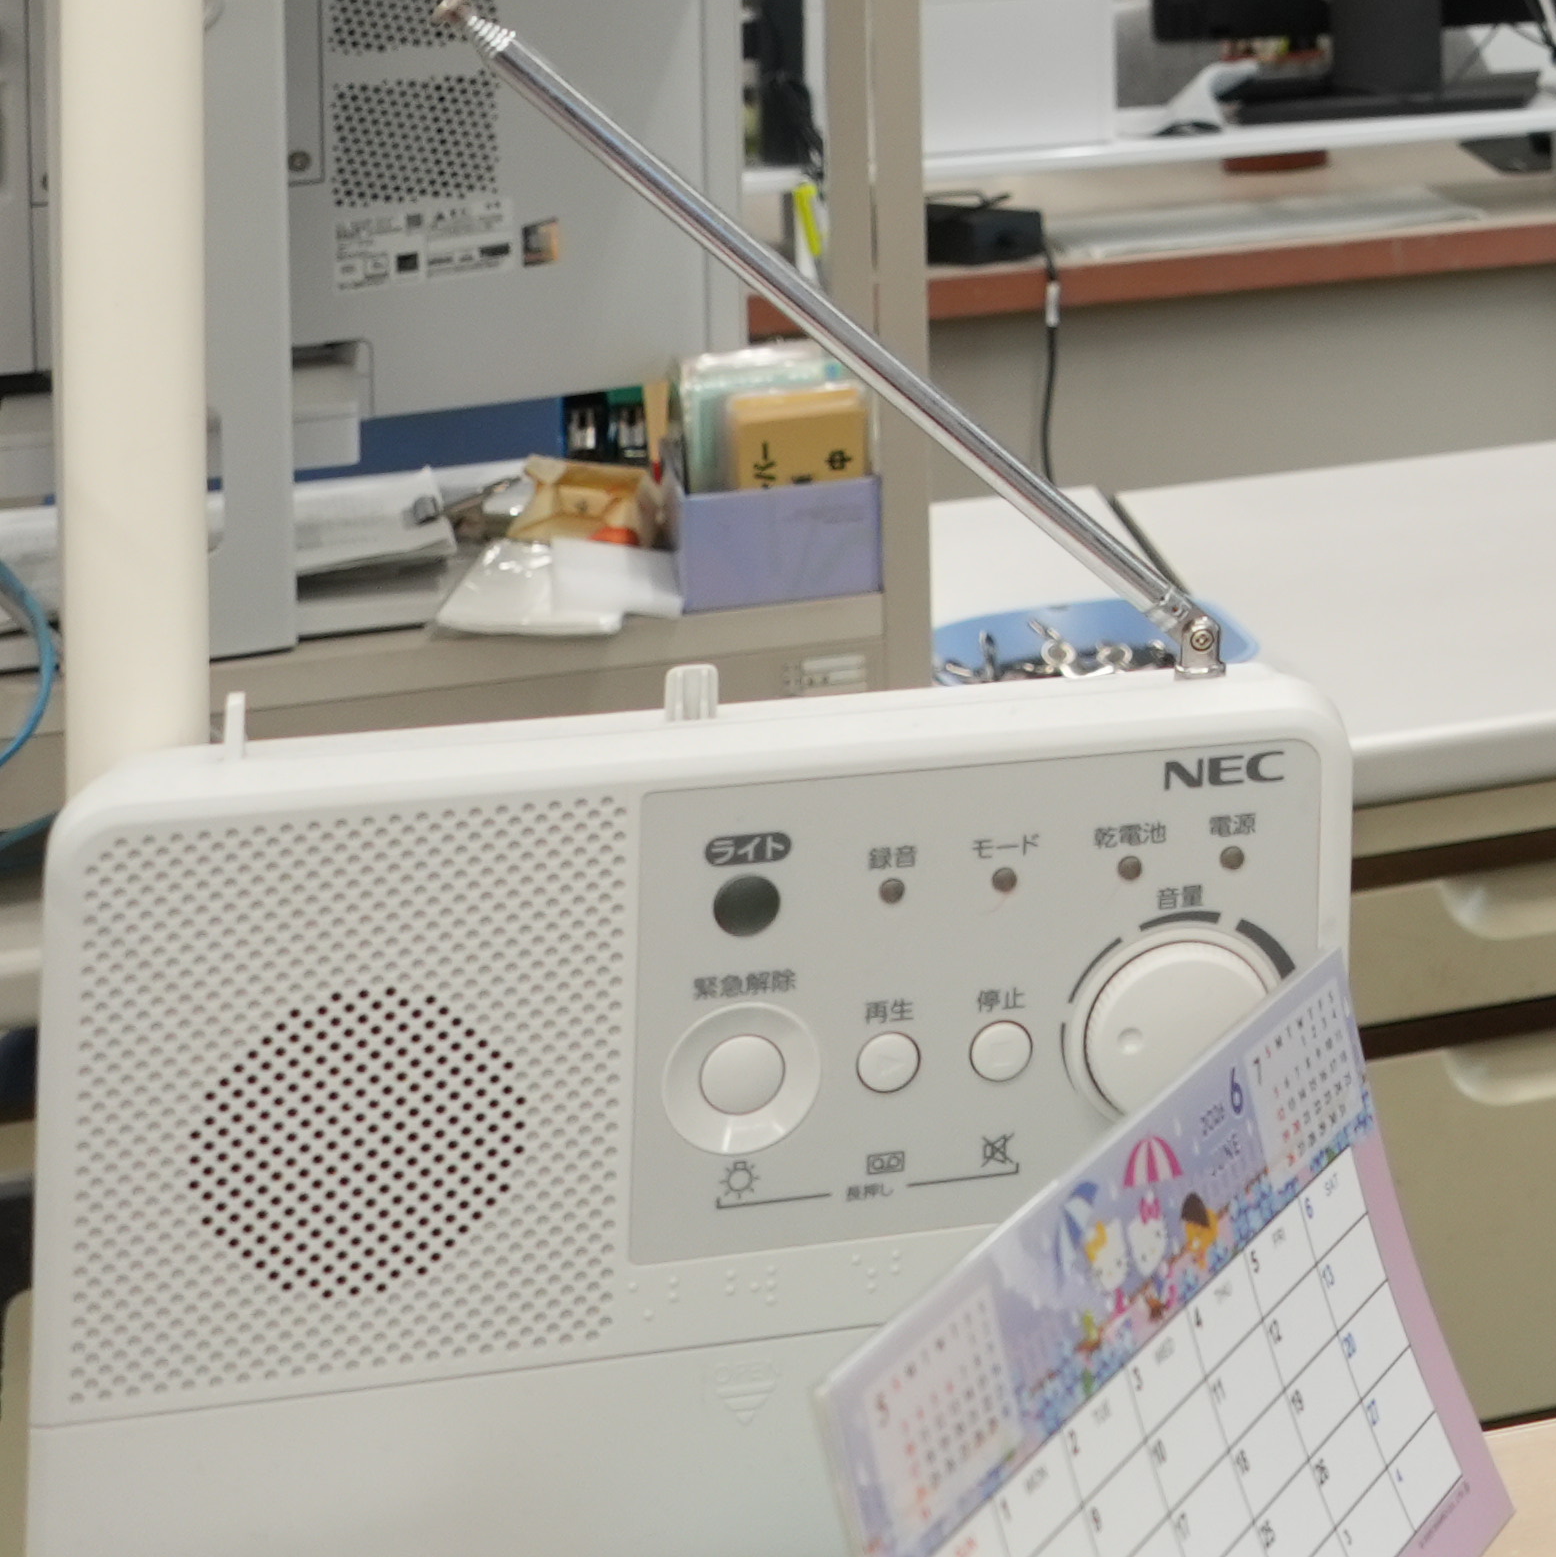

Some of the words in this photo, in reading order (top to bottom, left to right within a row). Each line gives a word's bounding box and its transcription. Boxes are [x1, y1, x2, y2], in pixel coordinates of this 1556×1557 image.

[1164, 751, 1286, 790] NEC
[1094, 822, 1167, 848] 乾電池
[1209, 812, 1257, 838] 電源
[711, 837, 787, 862] ライト
[868, 845, 918, 870] 録音
[973, 832, 1041, 859] モード
[1157, 884, 1204, 910] 音量
[693, 970, 798, 1000] 緊急解除
[864, 999, 914, 1024] 再生
[977, 987, 1026, 1013] 停止
[1230, 1066, 1243, 1115] 6
[846, 1185, 894, 1202] 長押し
[1326, 1173, 1338, 1196] SAT
[1069, 1430, 1079, 1455] 2
[1132, 1367, 1143, 1391] 3
[1193, 1307, 1203, 1328] 4
[1251, 1250, 1259, 1272] 5
[1304, 1197, 1314, 1219] 6
[1212, 1380, 1226, 1404] 11
[1268, 1319, 1282, 1344] 12
[1321, 1264, 1334, 1288] 13
[1342, 1332, 1357, 1358] 20
